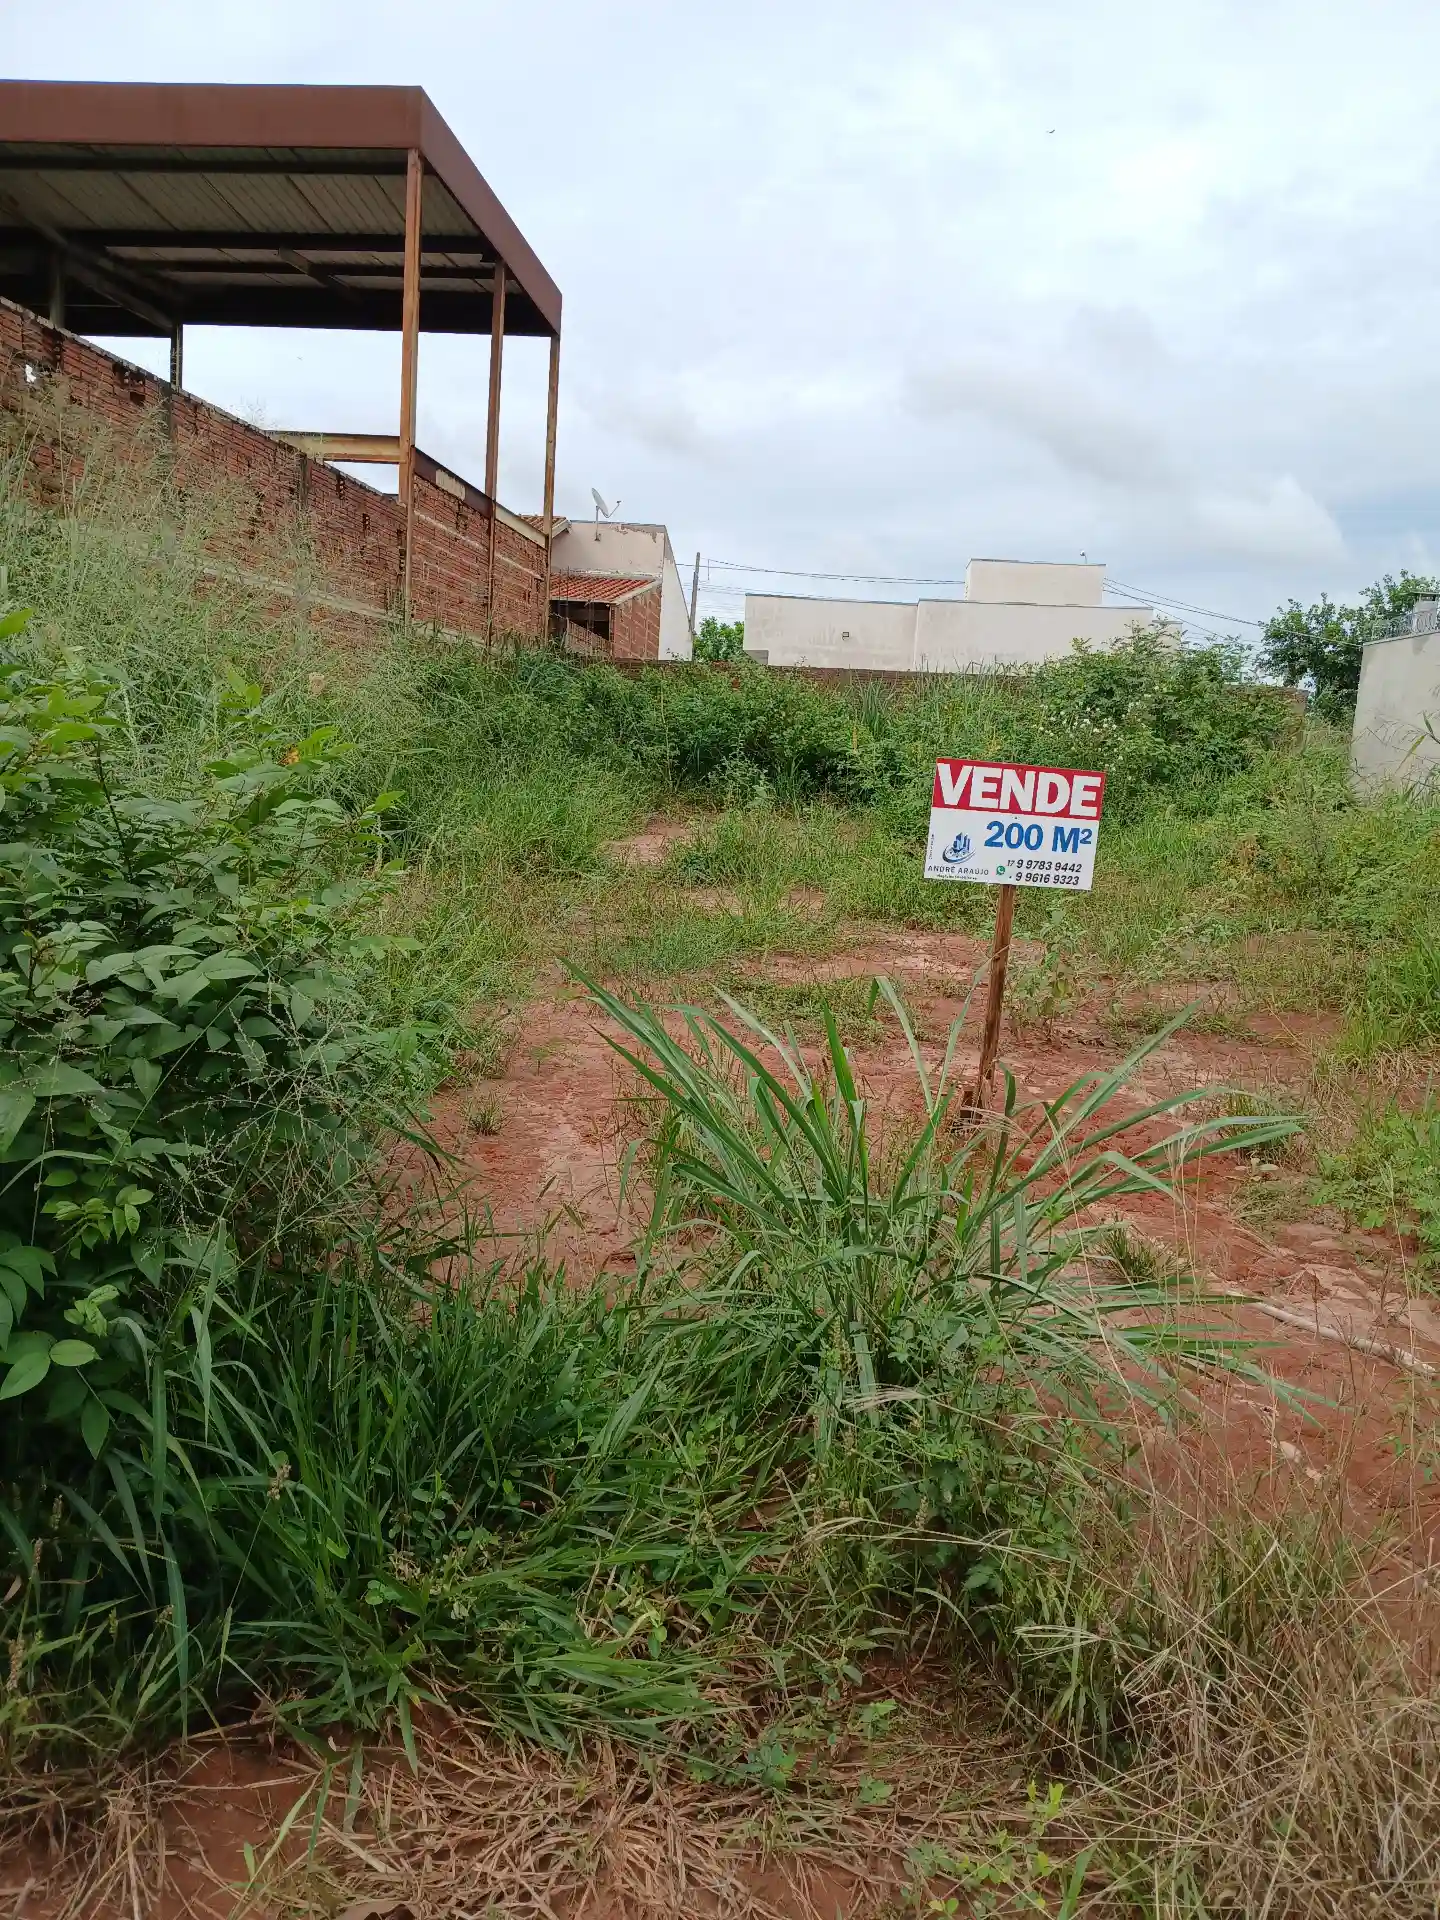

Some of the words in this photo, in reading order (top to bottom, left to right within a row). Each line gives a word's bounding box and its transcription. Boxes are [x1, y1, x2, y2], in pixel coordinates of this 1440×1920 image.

[937, 763, 1101, 817] VENDE
[984, 820, 1043, 850] 200
[927, 865, 956, 874] ANDRÉ
[957, 867, 989, 876] ARAÚJO
[1016, 859, 1024, 869] 9
[1025, 860, 1053, 870] 9783
[1054, 862, 1082, 872] 9442
[1015, 871, 1023, 881] 9
[1024, 872, 1051, 883] 9616
[1053, 874, 1080, 885] 9323
